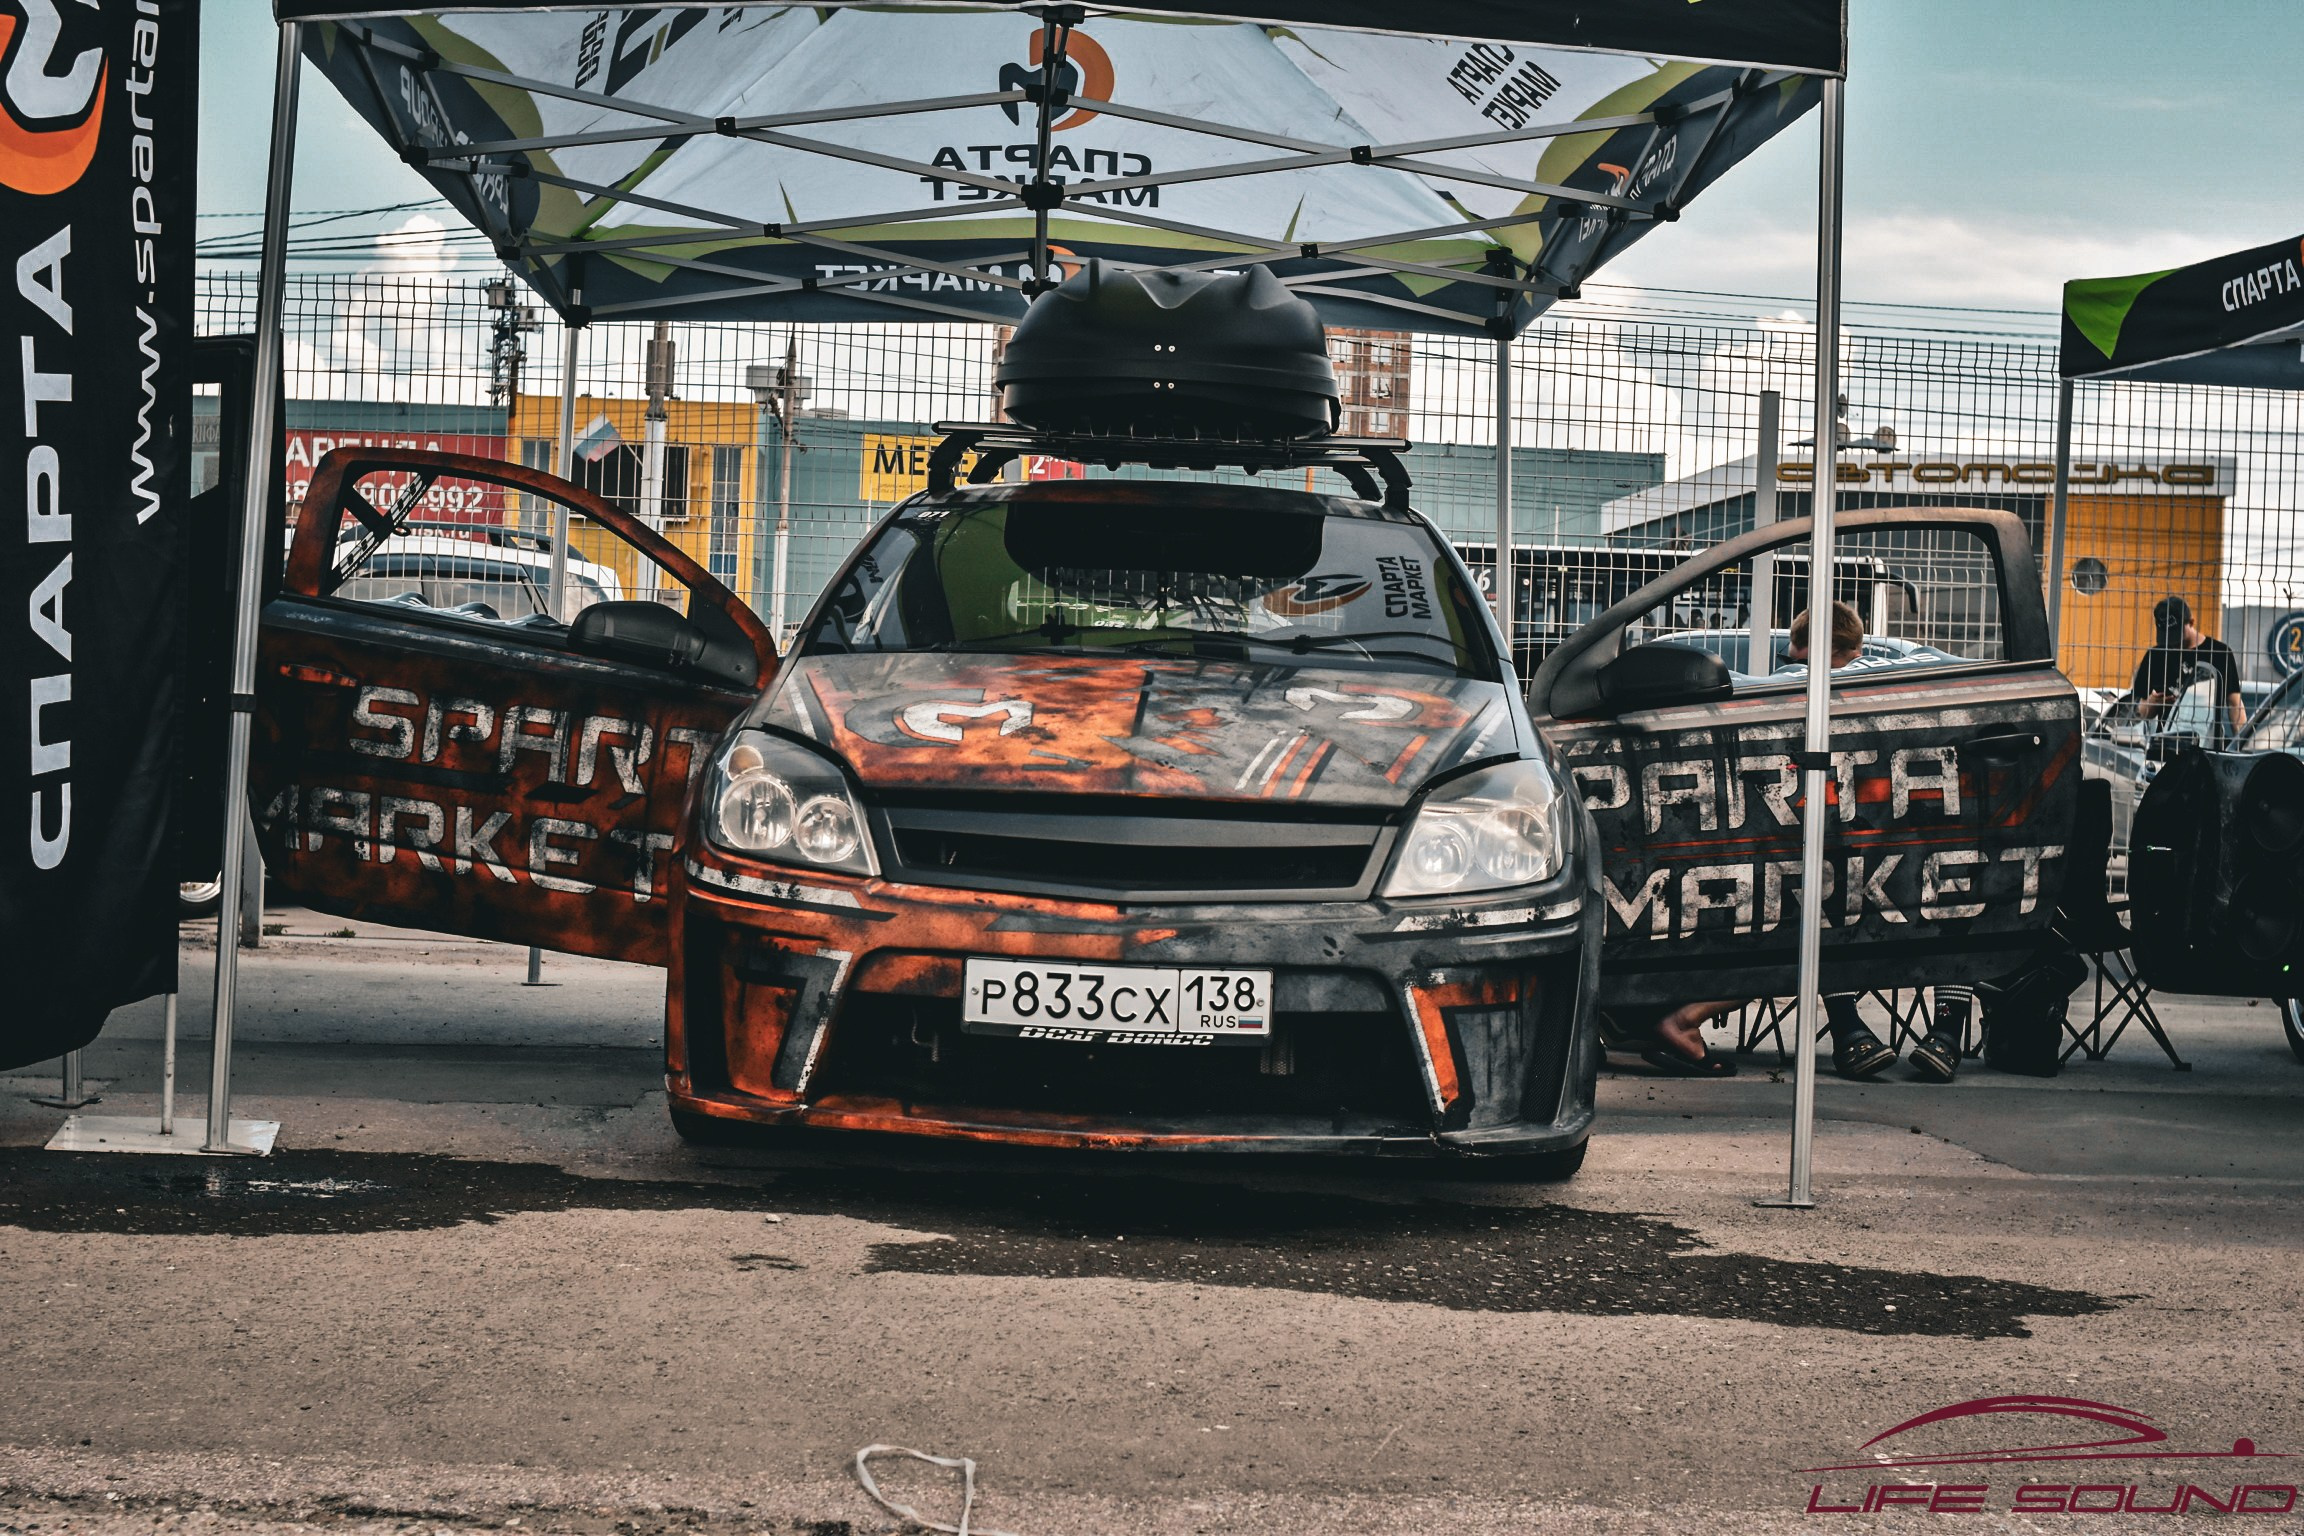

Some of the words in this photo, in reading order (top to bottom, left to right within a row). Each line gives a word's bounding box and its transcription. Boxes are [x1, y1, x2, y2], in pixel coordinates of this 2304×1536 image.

[2222, 258, 2301, 312] СПАРТА
[16, 223, 73, 870] СПАРТА
[1376, 556, 1408, 618] СПАРТА
[1399, 555, 1432, 619] МАРКЕТ
[2290, 626, 2304, 652] 2
[263, 784, 675, 902] MARKET
[1602, 844, 2065, 944] MARKET
[1184, 975, 1256, 1012] 138
[1200, 1014, 1236, 1028] RUS
